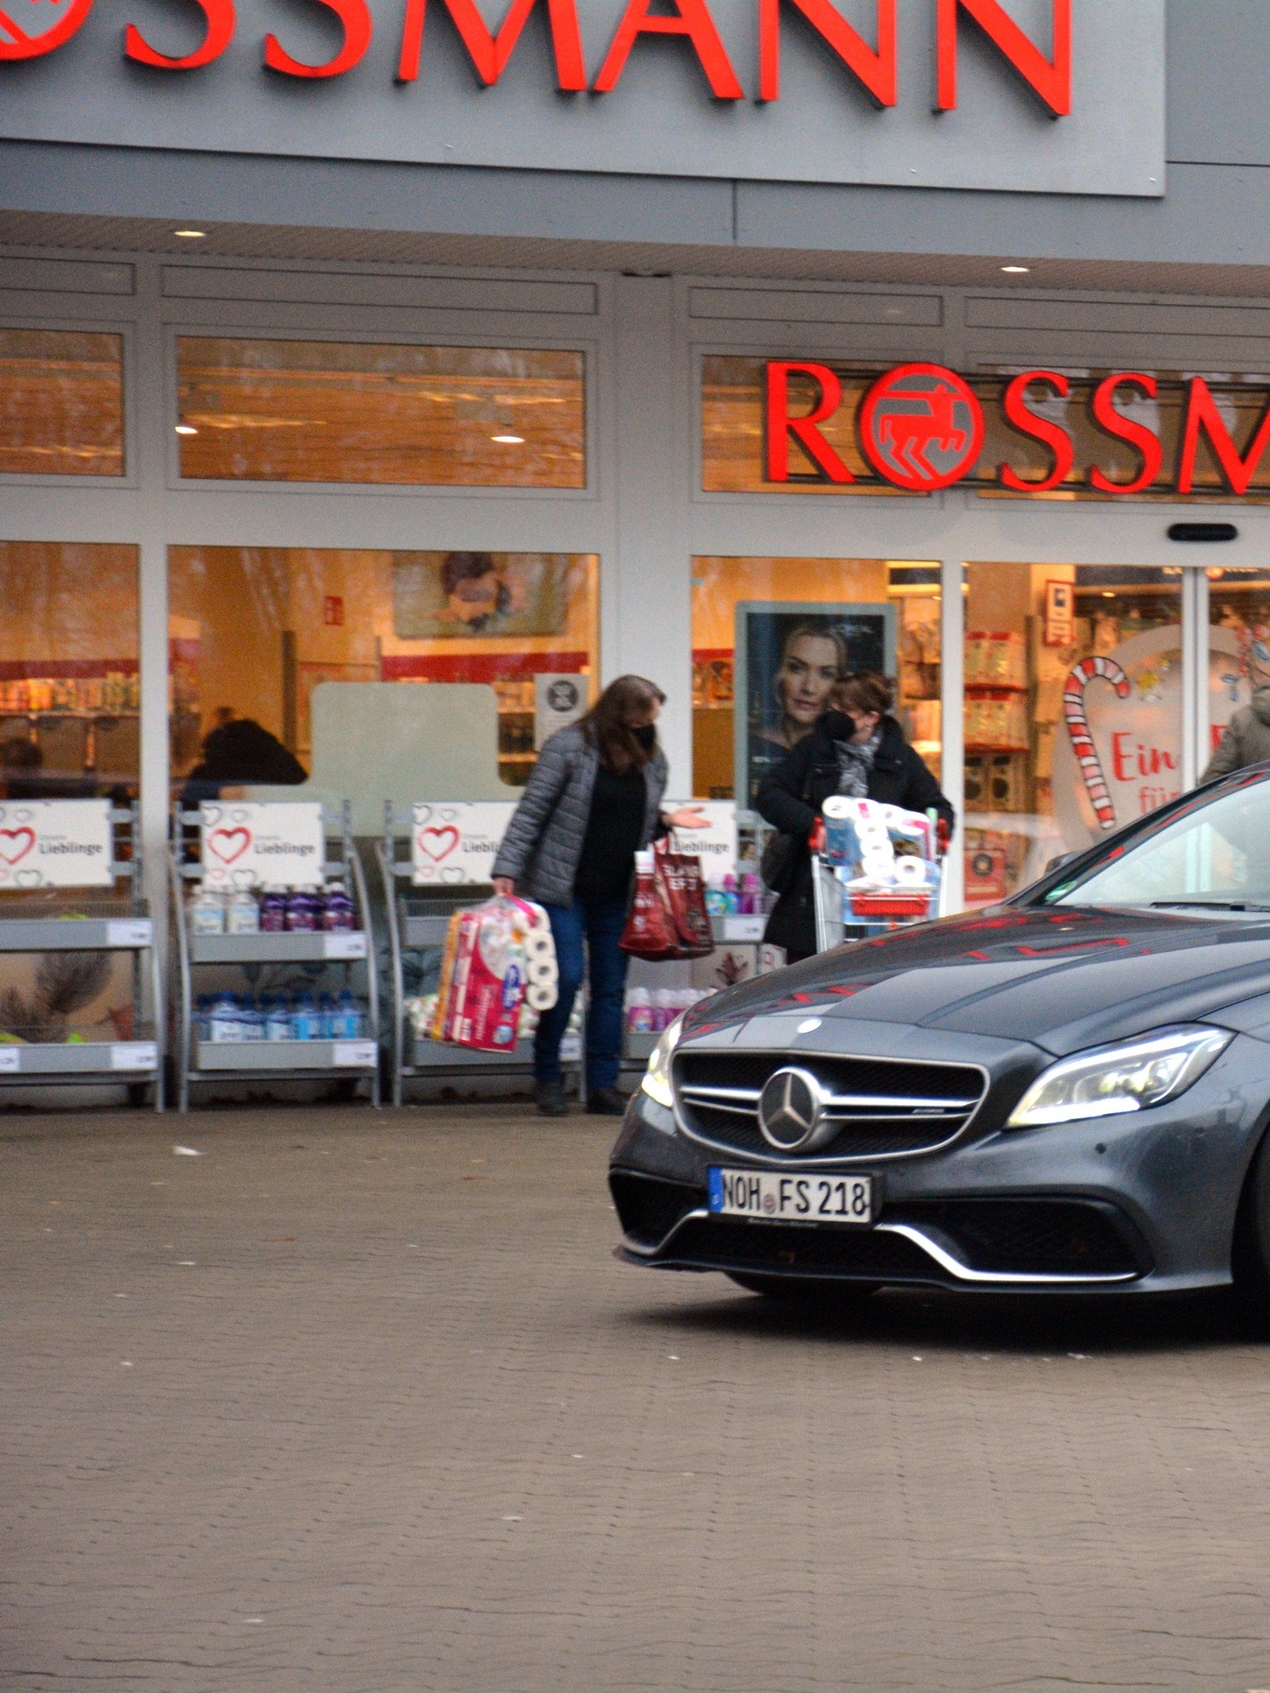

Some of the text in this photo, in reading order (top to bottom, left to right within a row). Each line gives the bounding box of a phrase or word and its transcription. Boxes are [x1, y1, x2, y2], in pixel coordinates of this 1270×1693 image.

[1111, 732, 1177, 782] Ein
[38, 841, 103, 856] Lieblinge
[253, 841, 316, 857] Lieblinge
[723, 1173, 866, 1216] NOH FS 218
